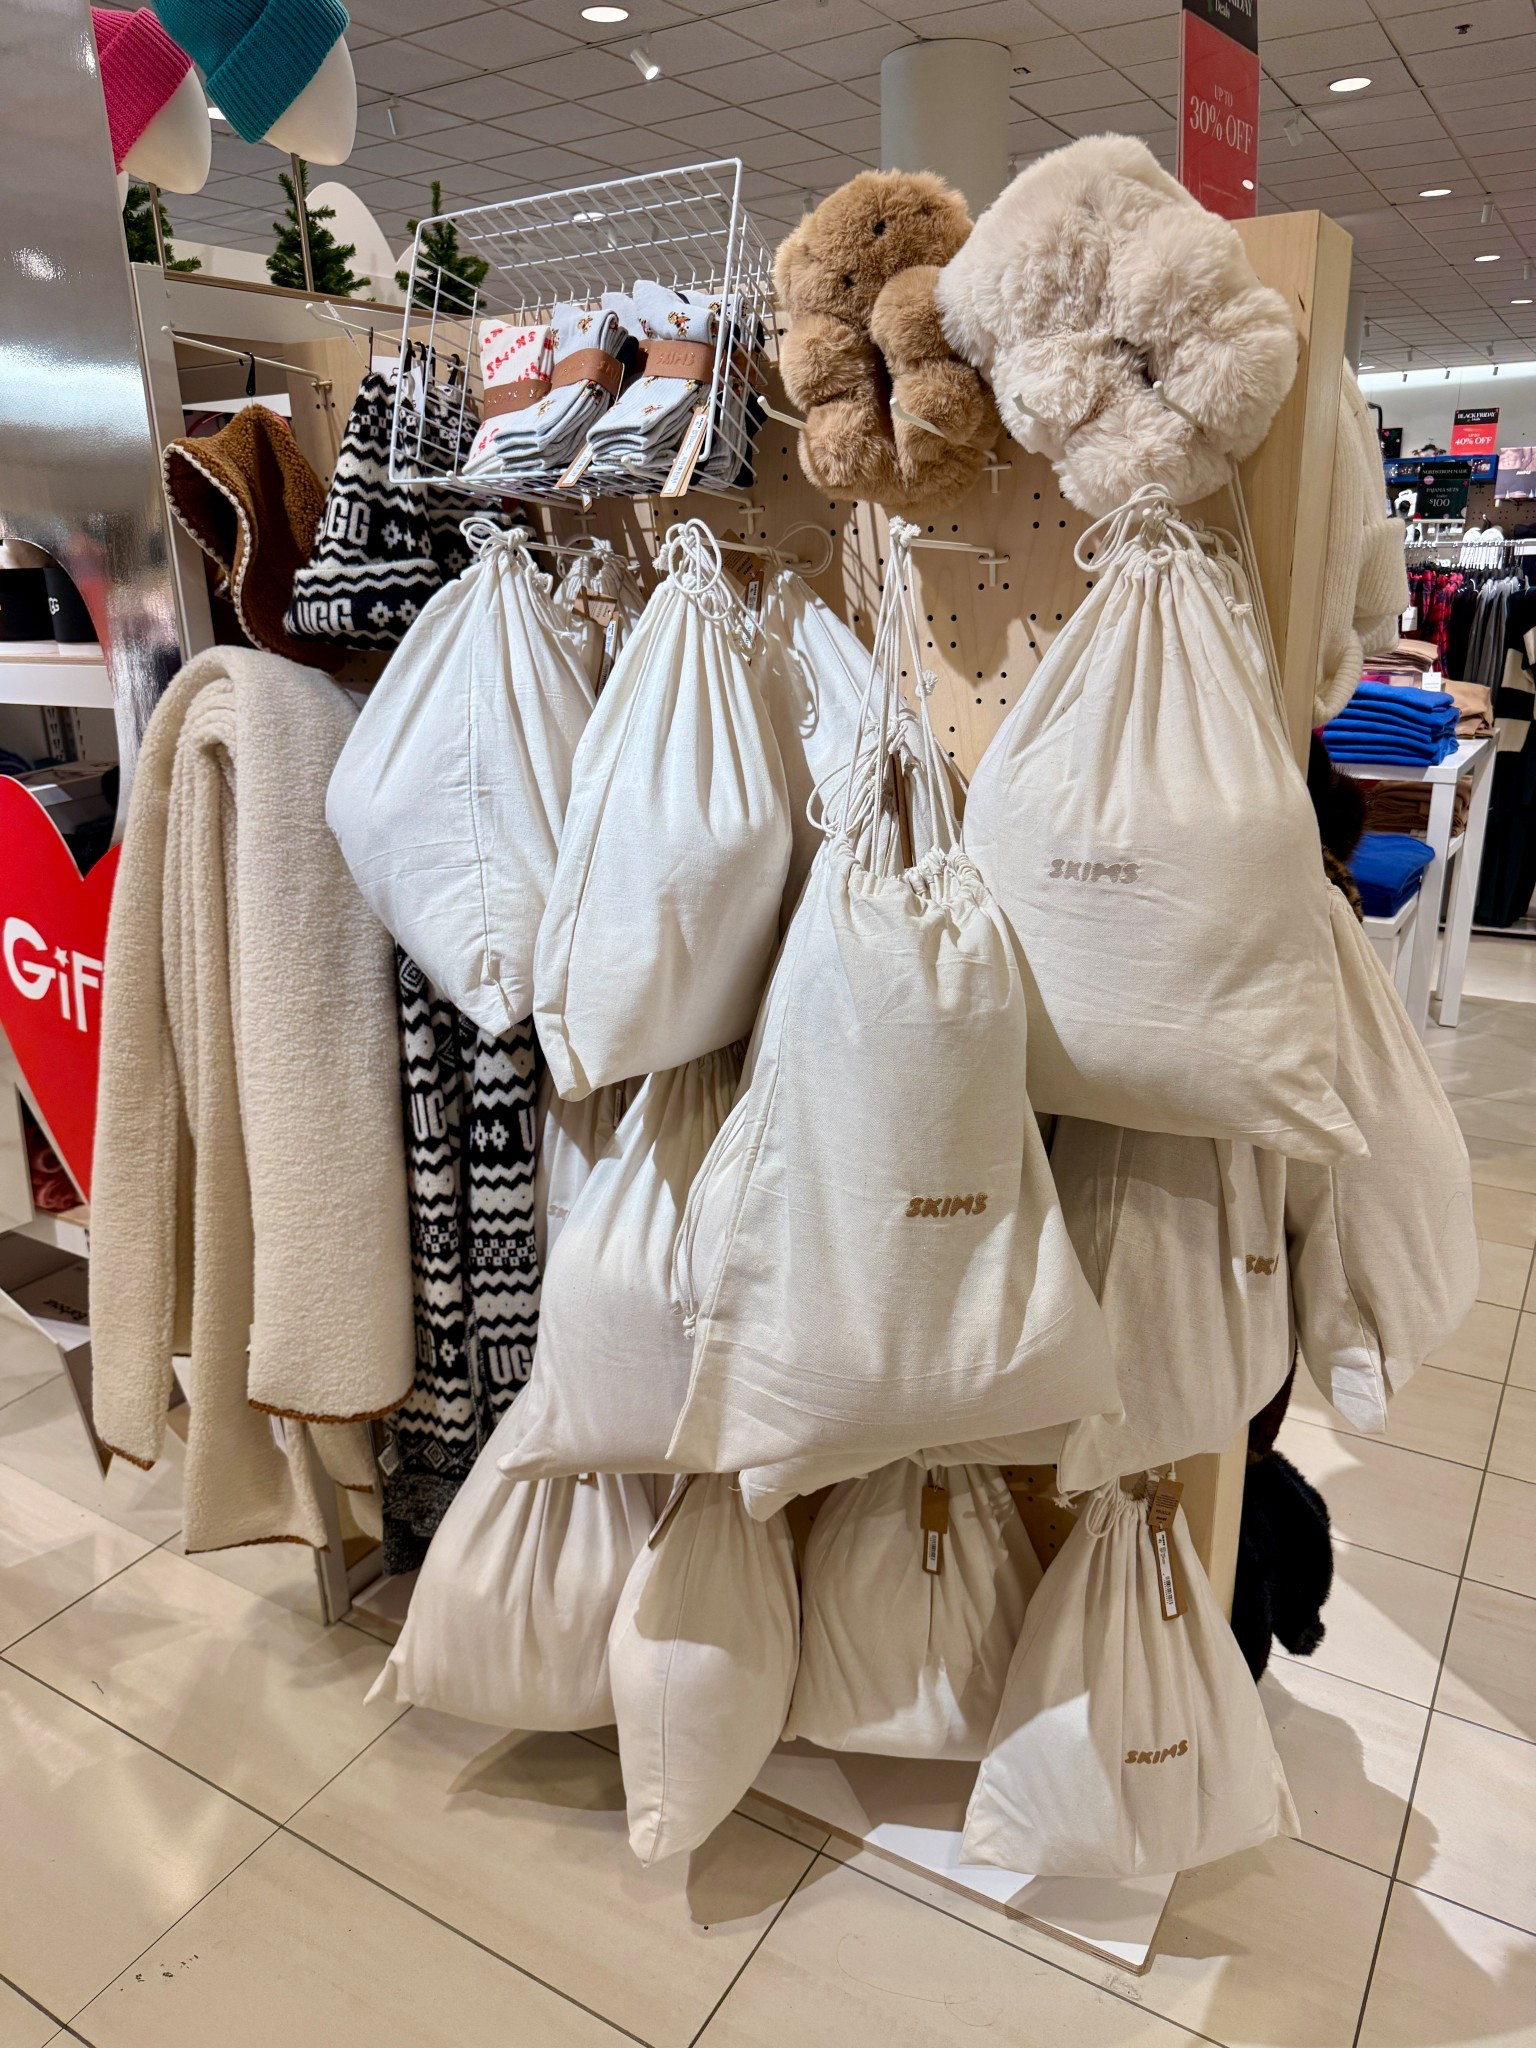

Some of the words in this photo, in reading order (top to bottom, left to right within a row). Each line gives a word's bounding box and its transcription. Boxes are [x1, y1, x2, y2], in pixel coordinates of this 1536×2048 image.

[1215, 84, 1224, 101] UP
[1224, 90, 1233, 107] TO
[1190, 95, 1223, 141] 30%
[1226, 114, 1254, 154] OFF
[1475, 436, 1493, 444] OFF
[1430, 498, 1450, 507] $100
[297, 598, 355, 634] UGG
[1047, 858, 1140, 884] SKIMS
[905, 1192, 988, 1217] SKIMS
[1246, 1253, 1279, 1276] SK
[488, 1343, 537, 1385] UG
[1124, 1739, 1189, 1765] SKIMS
